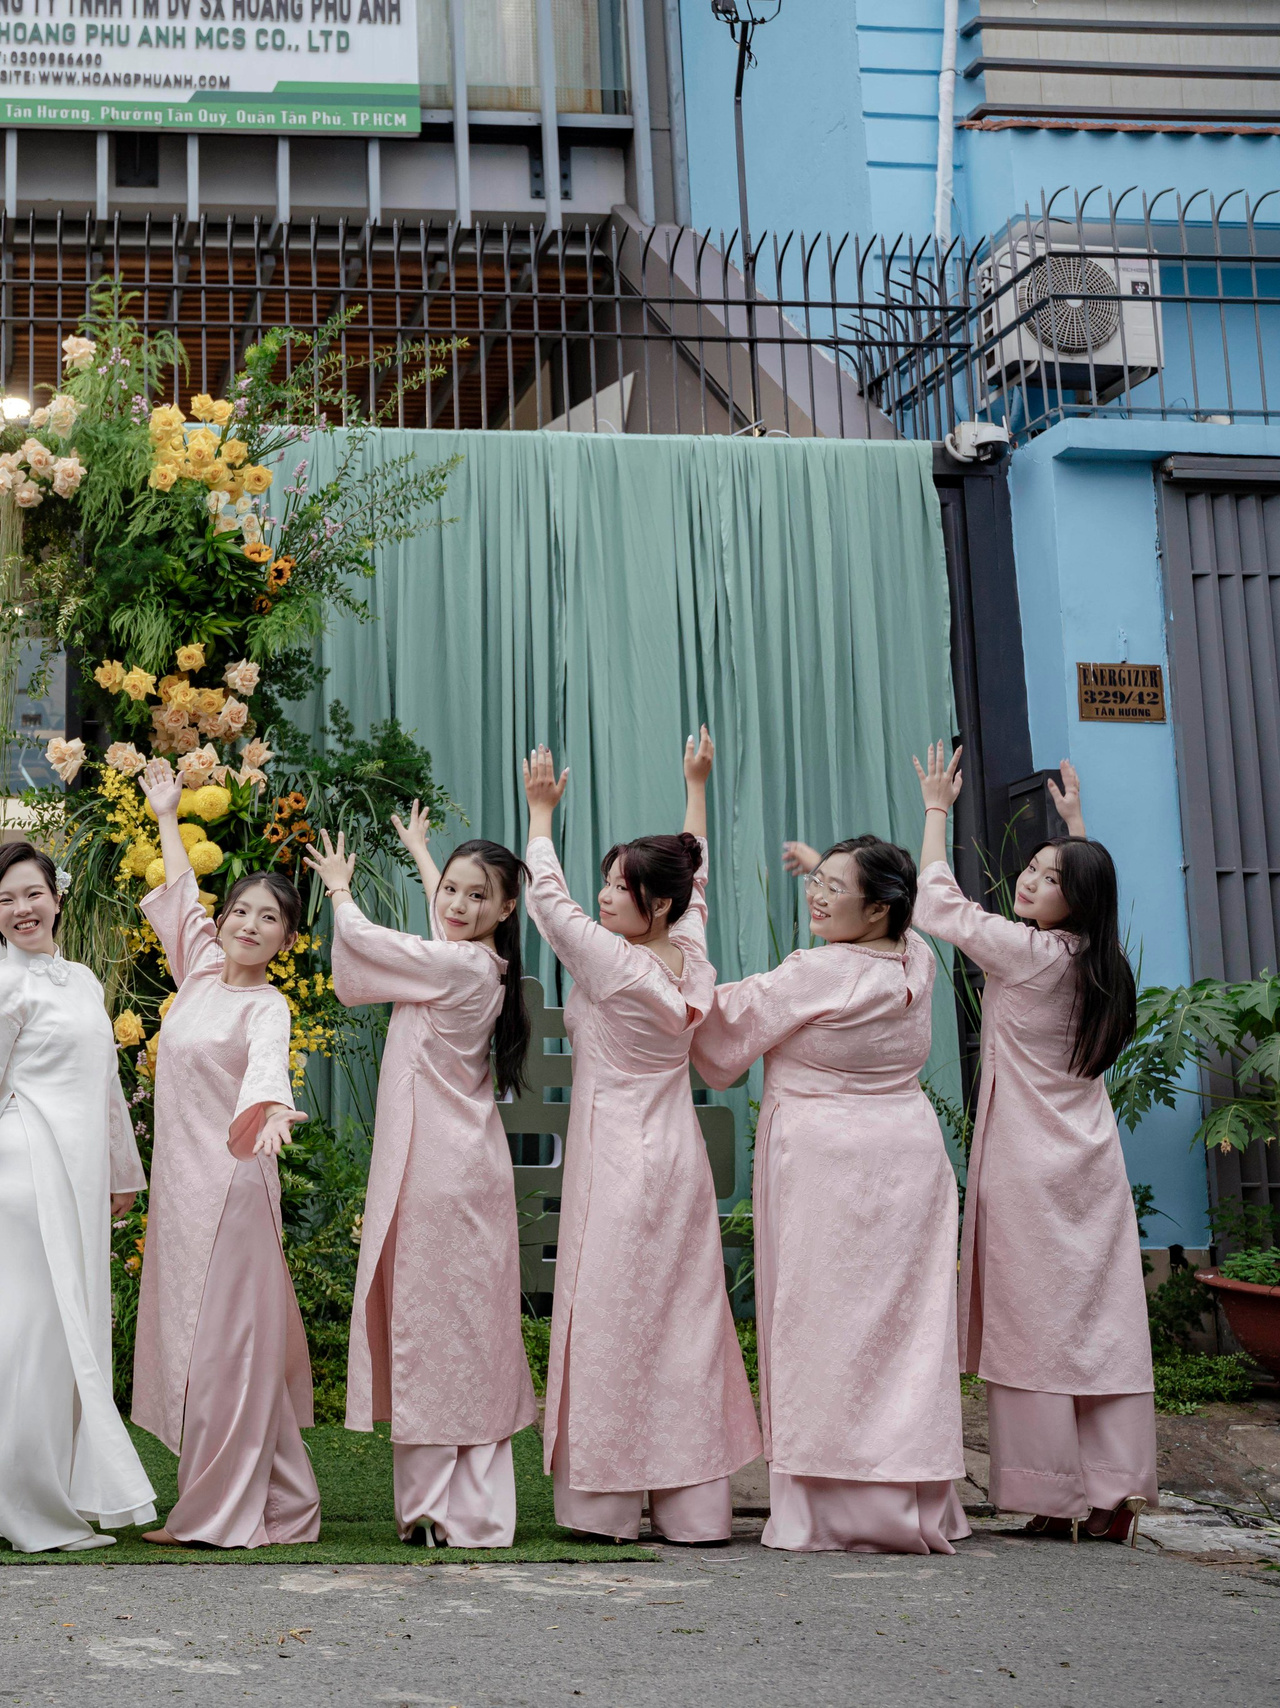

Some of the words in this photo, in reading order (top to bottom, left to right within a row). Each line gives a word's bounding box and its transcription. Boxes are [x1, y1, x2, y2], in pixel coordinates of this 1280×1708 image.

[358, 0, 401, 24] ANH
[86, 24, 130, 47] PHU
[138, 25, 186, 48] ANH
[195, 27, 246, 50] MCS
[308, 30, 350, 52] LTD
[1082, 668, 1159, 688] ENERGIZER
[1084, 690, 1159, 705] 329/42
[1095, 706, 1115, 716] TÂN
